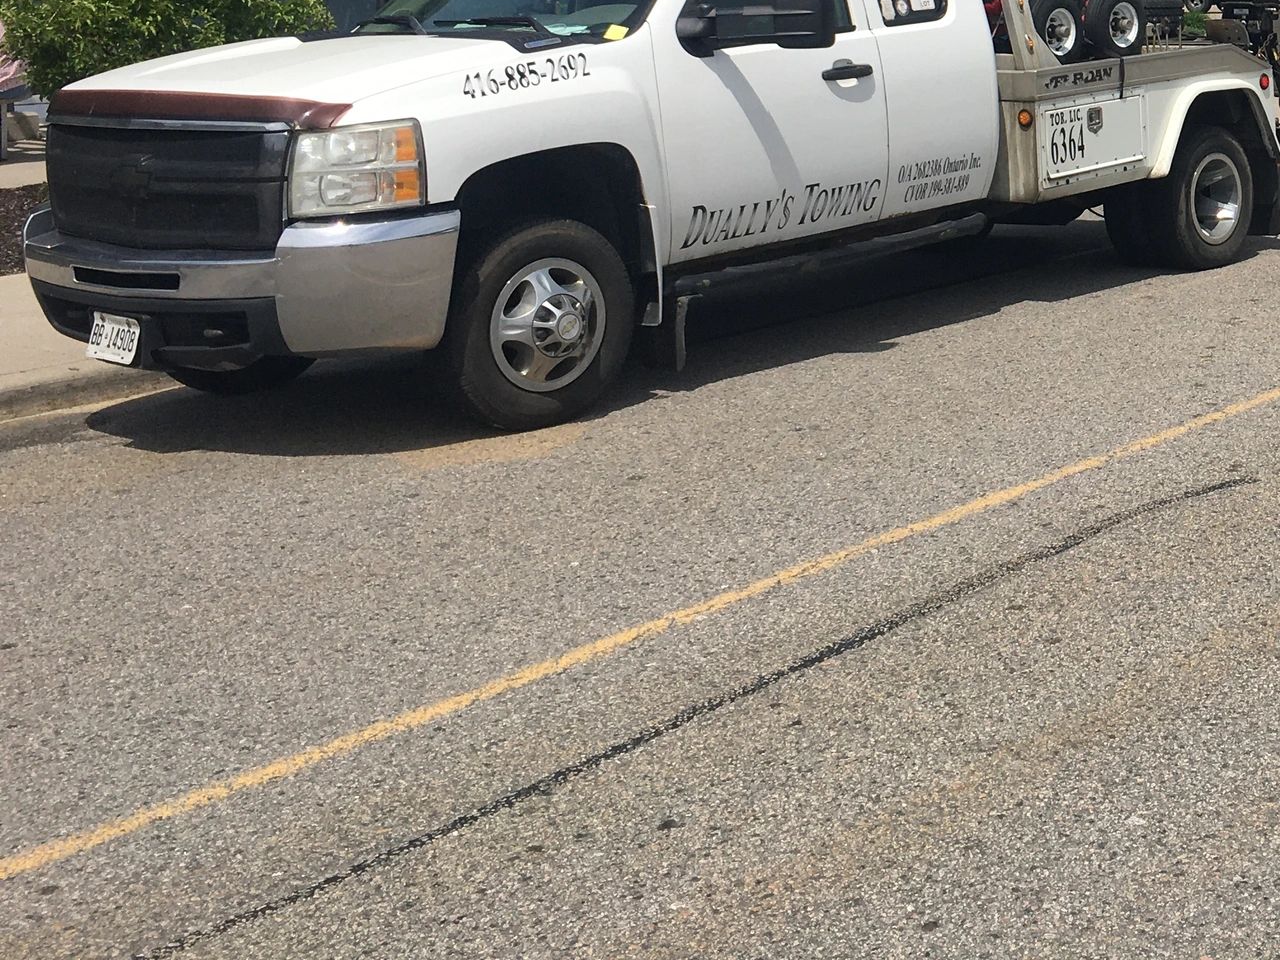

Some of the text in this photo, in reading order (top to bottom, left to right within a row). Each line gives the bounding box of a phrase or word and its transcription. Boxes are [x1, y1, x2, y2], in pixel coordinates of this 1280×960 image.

[463, 52, 591, 99] 416-885-2692
[1050, 108, 1083, 126] TOR. LIC.
[942, 153, 969, 175] Ontario
[1051, 123, 1085, 165] 6364
[798, 178, 881, 226] TOWING
